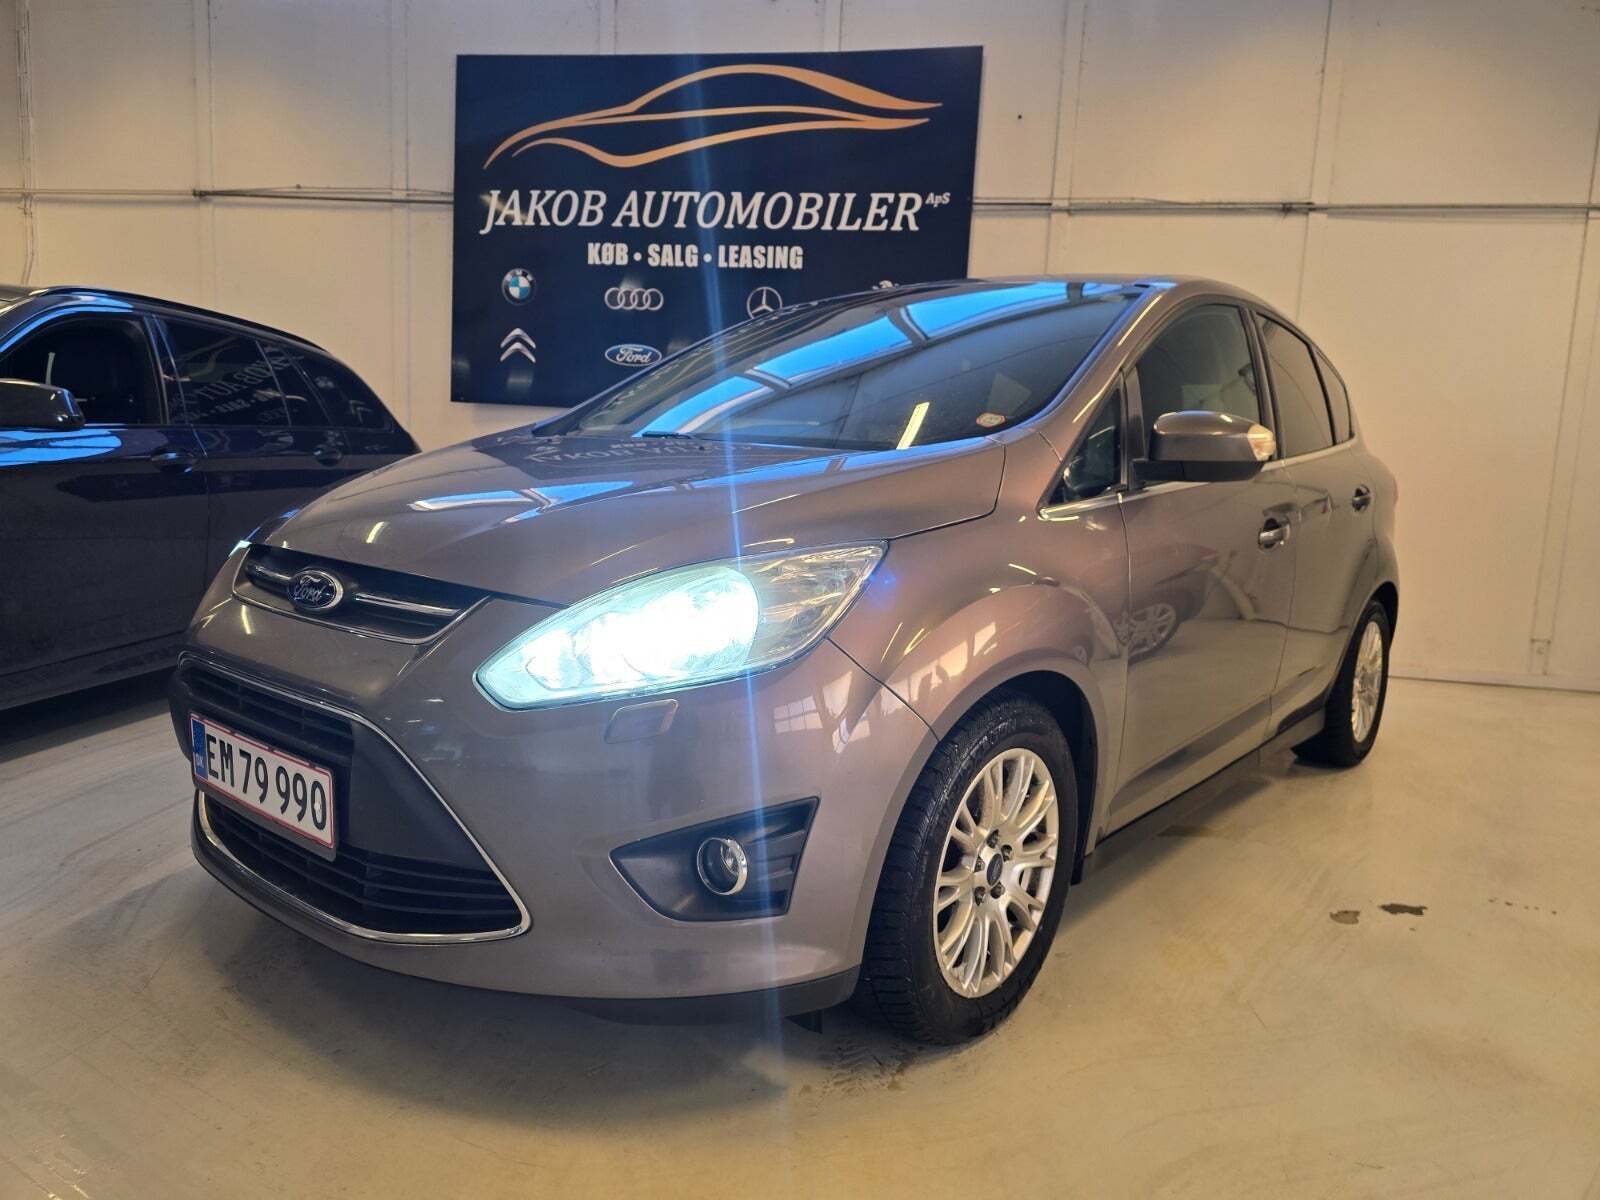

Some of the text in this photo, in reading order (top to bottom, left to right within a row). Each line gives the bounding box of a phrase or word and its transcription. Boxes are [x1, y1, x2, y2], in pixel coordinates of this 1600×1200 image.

[479, 189, 951, 235] JAKOB AUTOMOBILER ApS
[587, 242, 803, 269] KØB SALG LEASING
[615, 347, 652, 364] Ford
[294, 574, 327, 602] Ford
[206, 733, 327, 831] EM 79 990
